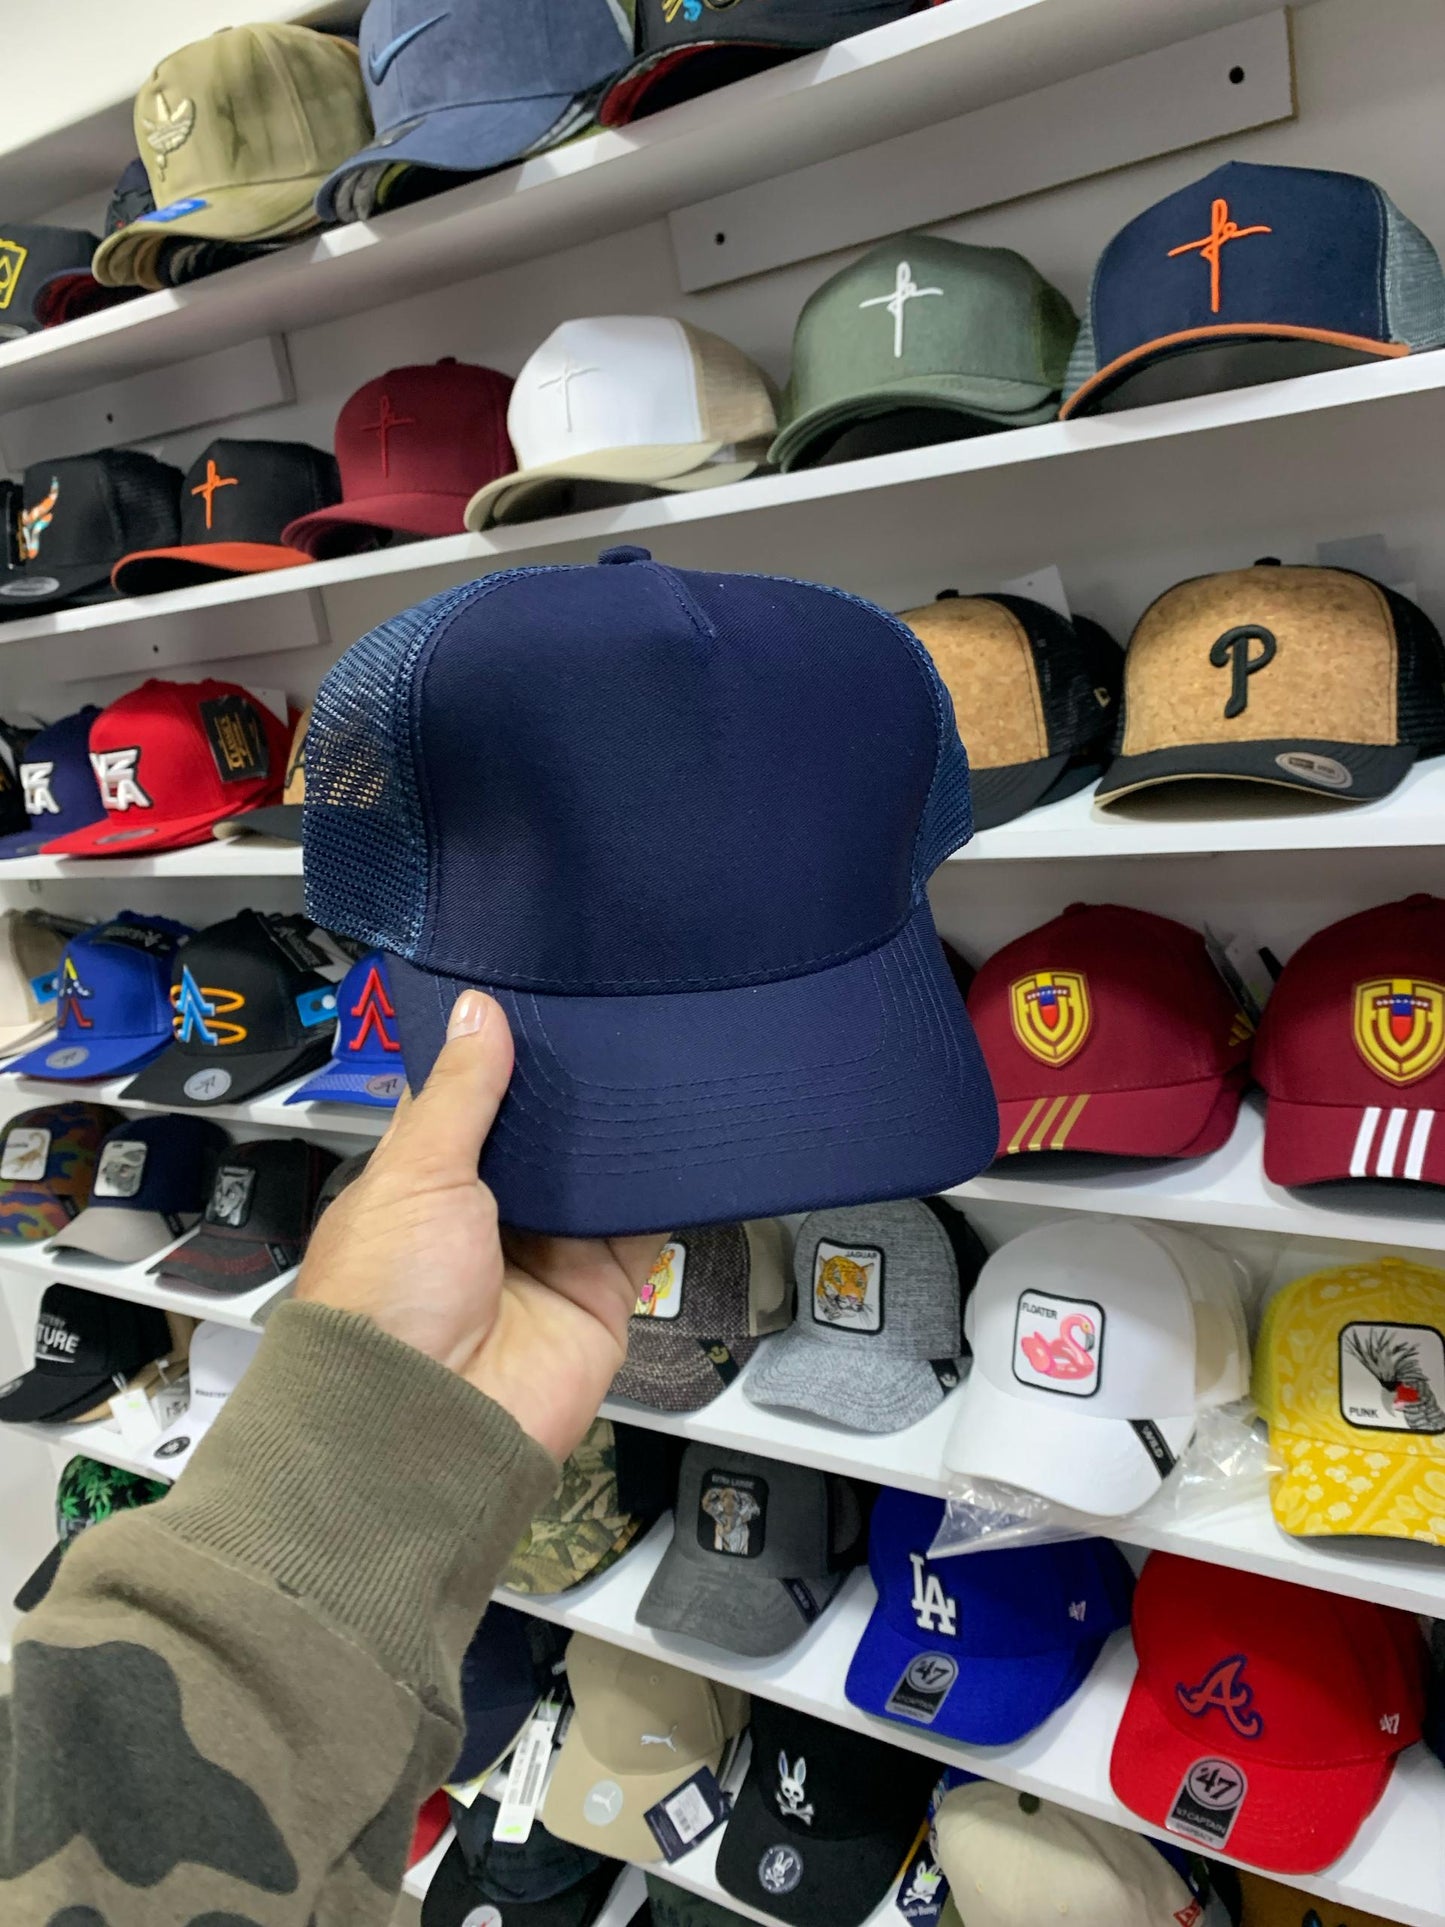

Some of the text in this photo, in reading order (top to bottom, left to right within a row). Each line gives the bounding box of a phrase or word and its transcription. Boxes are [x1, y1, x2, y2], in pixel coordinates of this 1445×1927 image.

[1209, 624, 1276, 719] P
[1022, 1302, 1058, 1320] FLOATER
[1349, 1406, 1379, 1418] PUNK
[909, 1552, 957, 1636] LA
[1175, 1654, 1263, 1740] A
